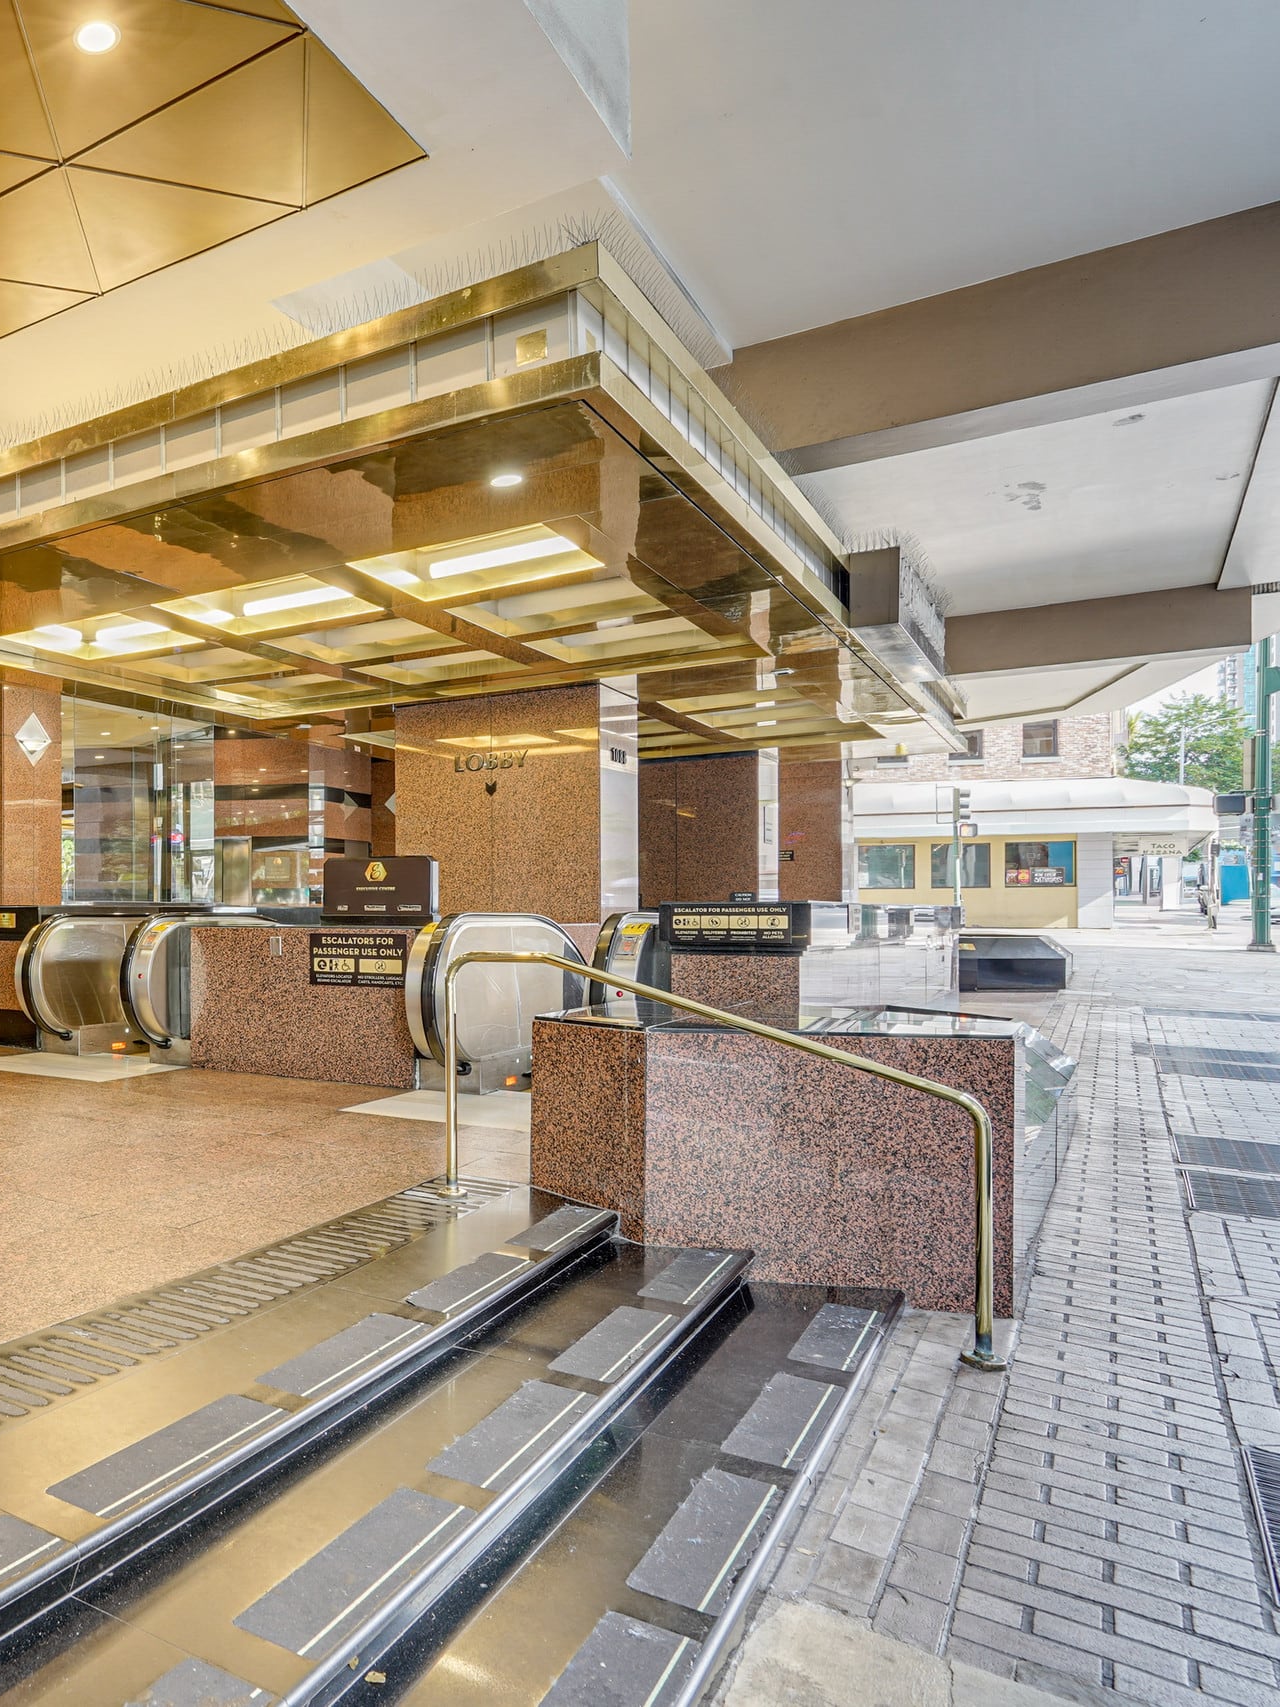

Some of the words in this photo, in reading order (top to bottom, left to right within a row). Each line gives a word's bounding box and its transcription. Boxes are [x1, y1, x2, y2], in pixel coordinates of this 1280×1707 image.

[454, 749, 529, 773] LOBBY
[321, 936, 374, 945] ESCALATORS
[375, 937, 394, 945] FOR
[313, 947, 360, 956] PASSENGER
[361, 948, 378, 956] USE
[379, 949, 403, 957] ONLY
